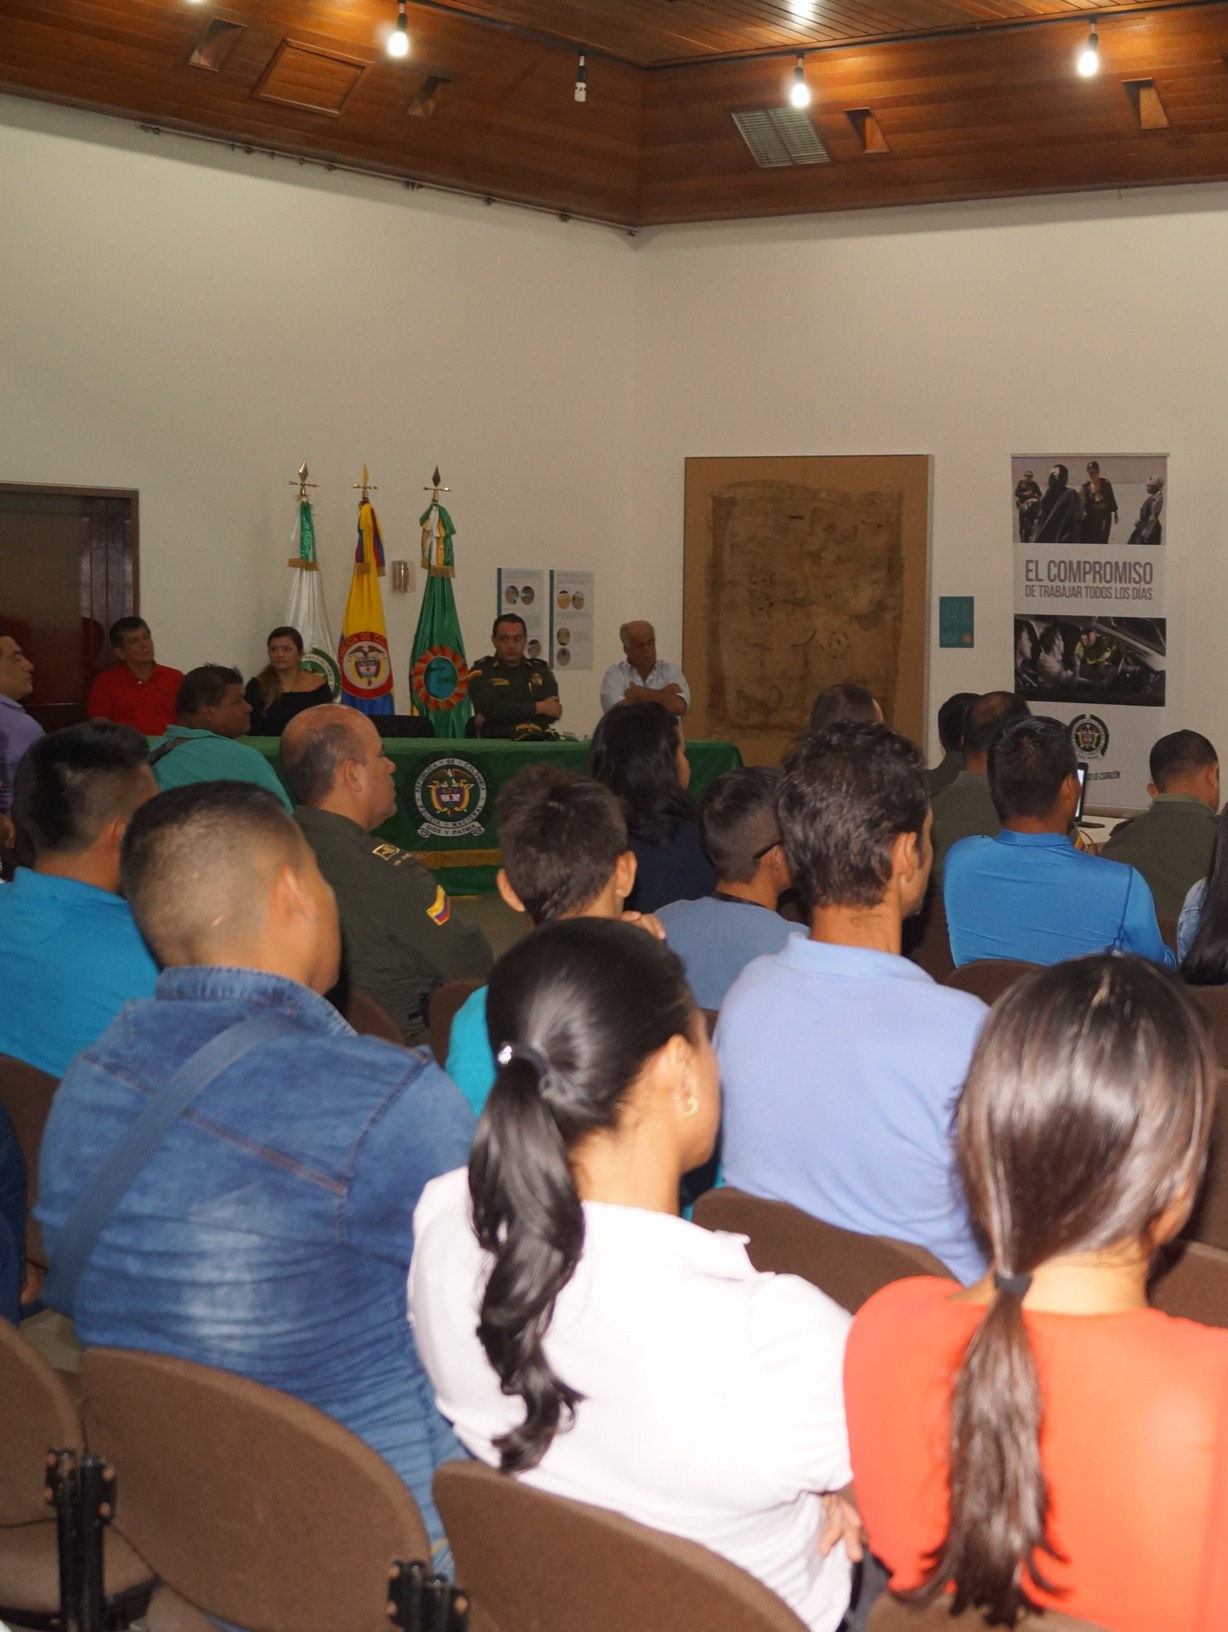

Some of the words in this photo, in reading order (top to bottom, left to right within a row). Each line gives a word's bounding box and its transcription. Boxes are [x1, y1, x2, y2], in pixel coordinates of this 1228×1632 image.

[1025, 559, 1044, 582] EL
[1047, 559, 1153, 584] COMPROMISO
[1025, 584, 1037, 598] DE
[1038, 585, 1082, 598] TRABAJAR
[1084, 586, 1113, 599] TODOS
[1114, 586, 1130, 600] LOS
[1132, 584, 1153, 600] DÍAS
